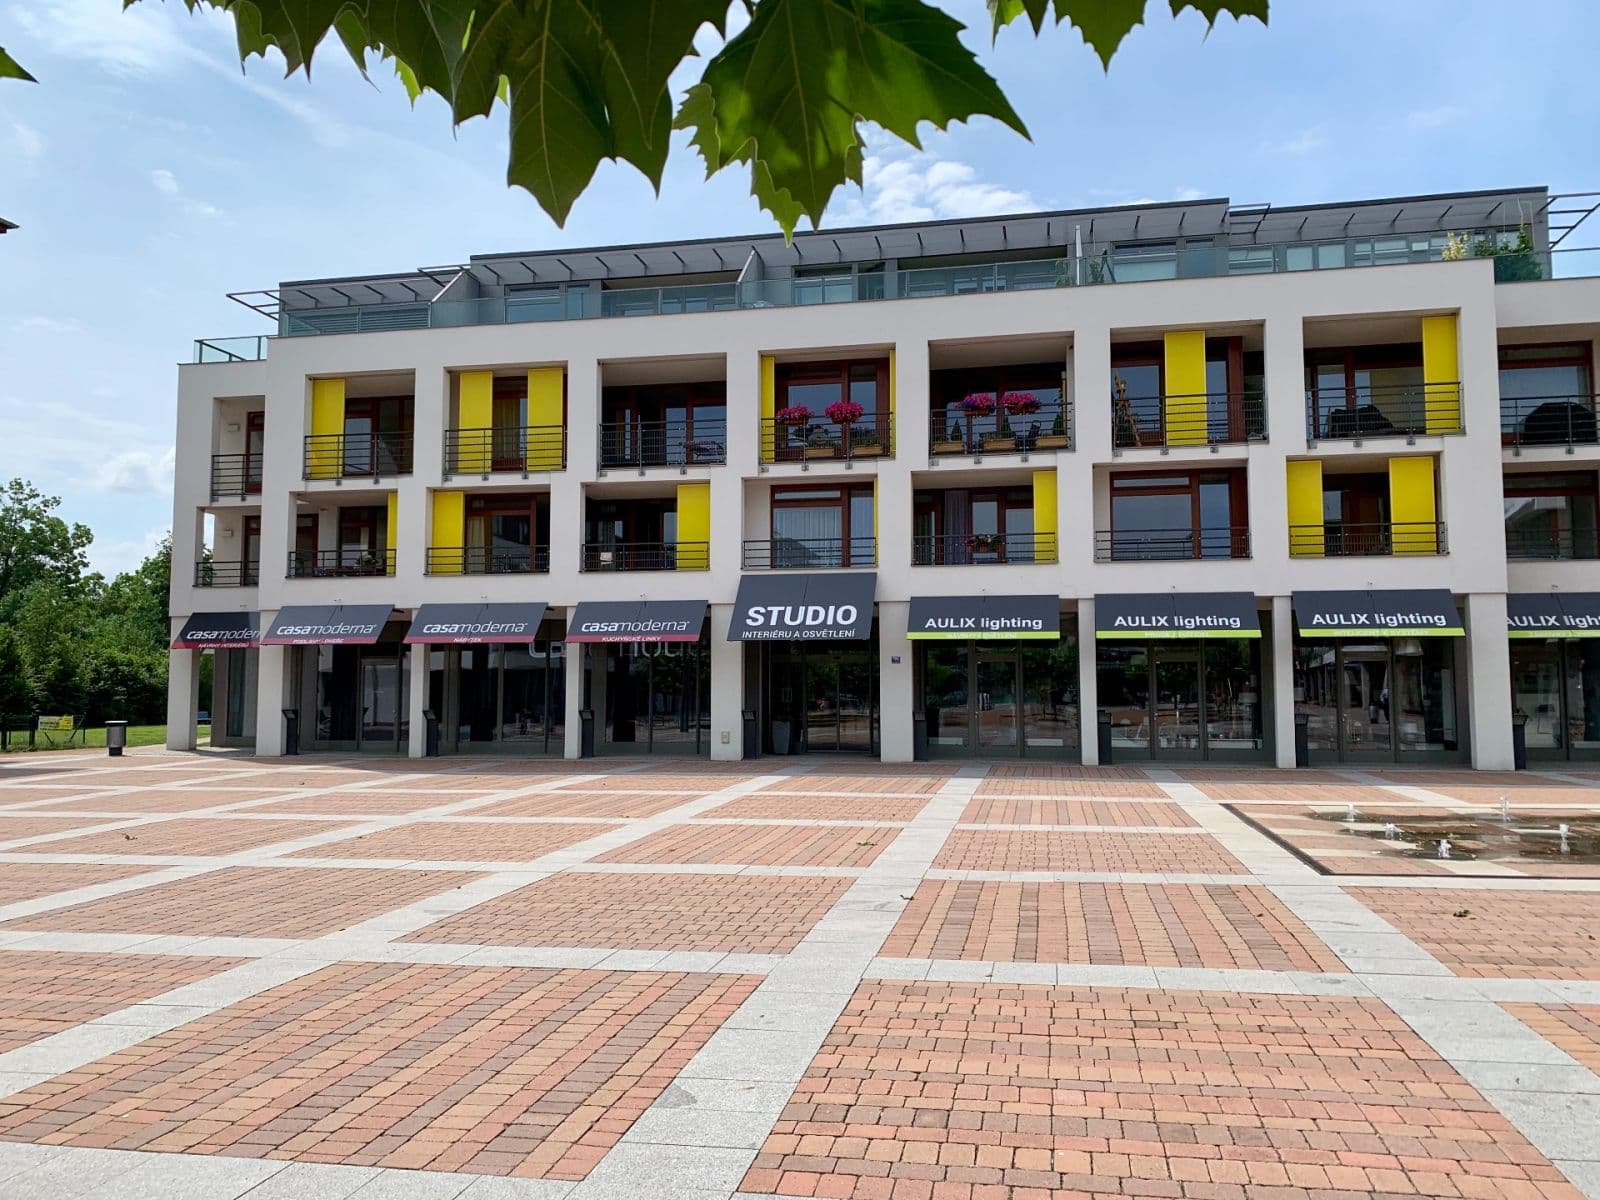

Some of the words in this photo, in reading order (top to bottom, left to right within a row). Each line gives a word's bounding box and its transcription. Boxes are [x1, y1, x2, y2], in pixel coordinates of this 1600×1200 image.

[746, 605, 857, 626] STUDIO
[1114, 615, 1169, 627] AULIX
[1173, 615, 1241, 629] lighting
[1312, 613, 1370, 625] AULIX
[1374, 613, 1446, 627] lighting
[1562, 614, 1600, 628] ligh
[276, 622, 374, 635] casamoderna
[423, 621, 526, 634] casamoderna
[581, 619, 687, 632] casamoderna
[924, 617, 976, 629] AULIX
[980, 617, 1043, 630] lighting
[802, 628, 856, 638] OSVĚTLENÍ
